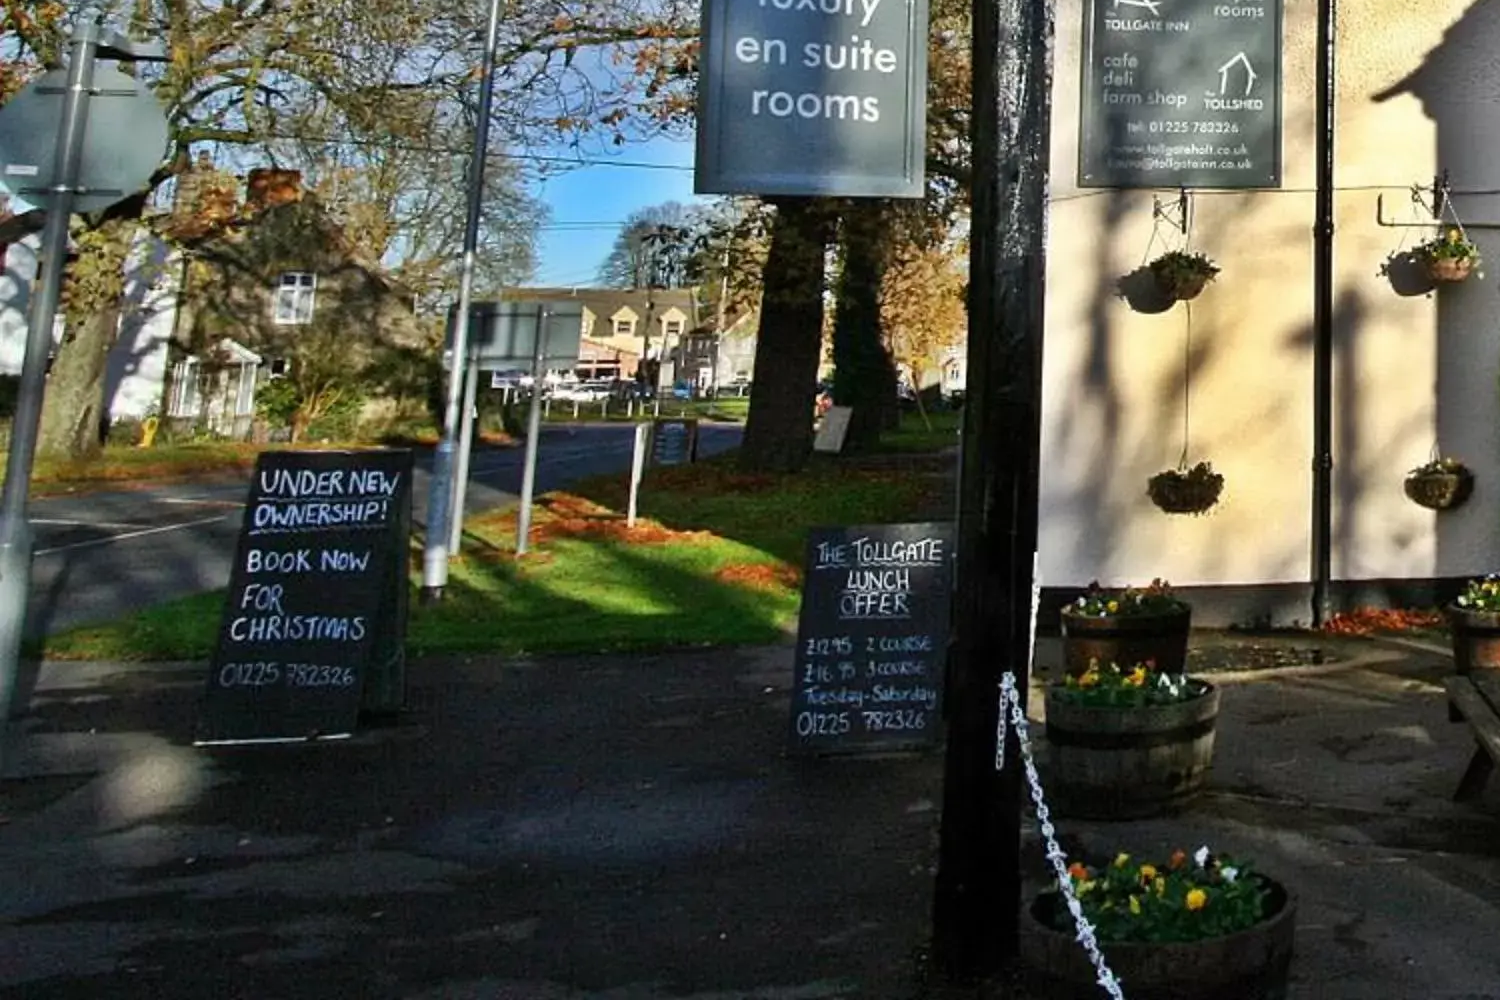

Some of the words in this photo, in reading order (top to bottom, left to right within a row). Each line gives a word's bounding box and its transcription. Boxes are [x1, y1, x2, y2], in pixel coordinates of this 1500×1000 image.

[1214, 5, 1265, 18] rooms
[1104, 19, 1162, 32] TOLLGATE
[735, 36, 786, 64] en
[803, 35, 897, 73] suite
[1103, 70, 1133, 86] deli
[751, 90, 880, 122] rooms
[1103, 88, 1142, 104] farm
[1147, 88, 1187, 109] shop
[261, 469, 344, 497] UNDER
[349, 470, 400, 495] NEW
[254, 500, 388, 527] OWNERSHIP!
[247, 550, 312, 573] BOOK
[321, 550, 370, 573] NOW
[816, 541, 847, 563] THE
[852, 537, 944, 562] TOLLGATE
[847, 568, 910, 591] LUNCH
[240, 584, 284, 615] FOR
[840, 592, 910, 615] OFFER
[230, 615, 366, 641] CHRISTMAS
[866, 637, 875, 652] 2
[219, 662, 280, 687] 01225
[286, 663, 355, 687] 782326
[865, 660, 876, 678] 3
[796, 711, 850, 736] 01225
[862, 709, 927, 731] 782326
